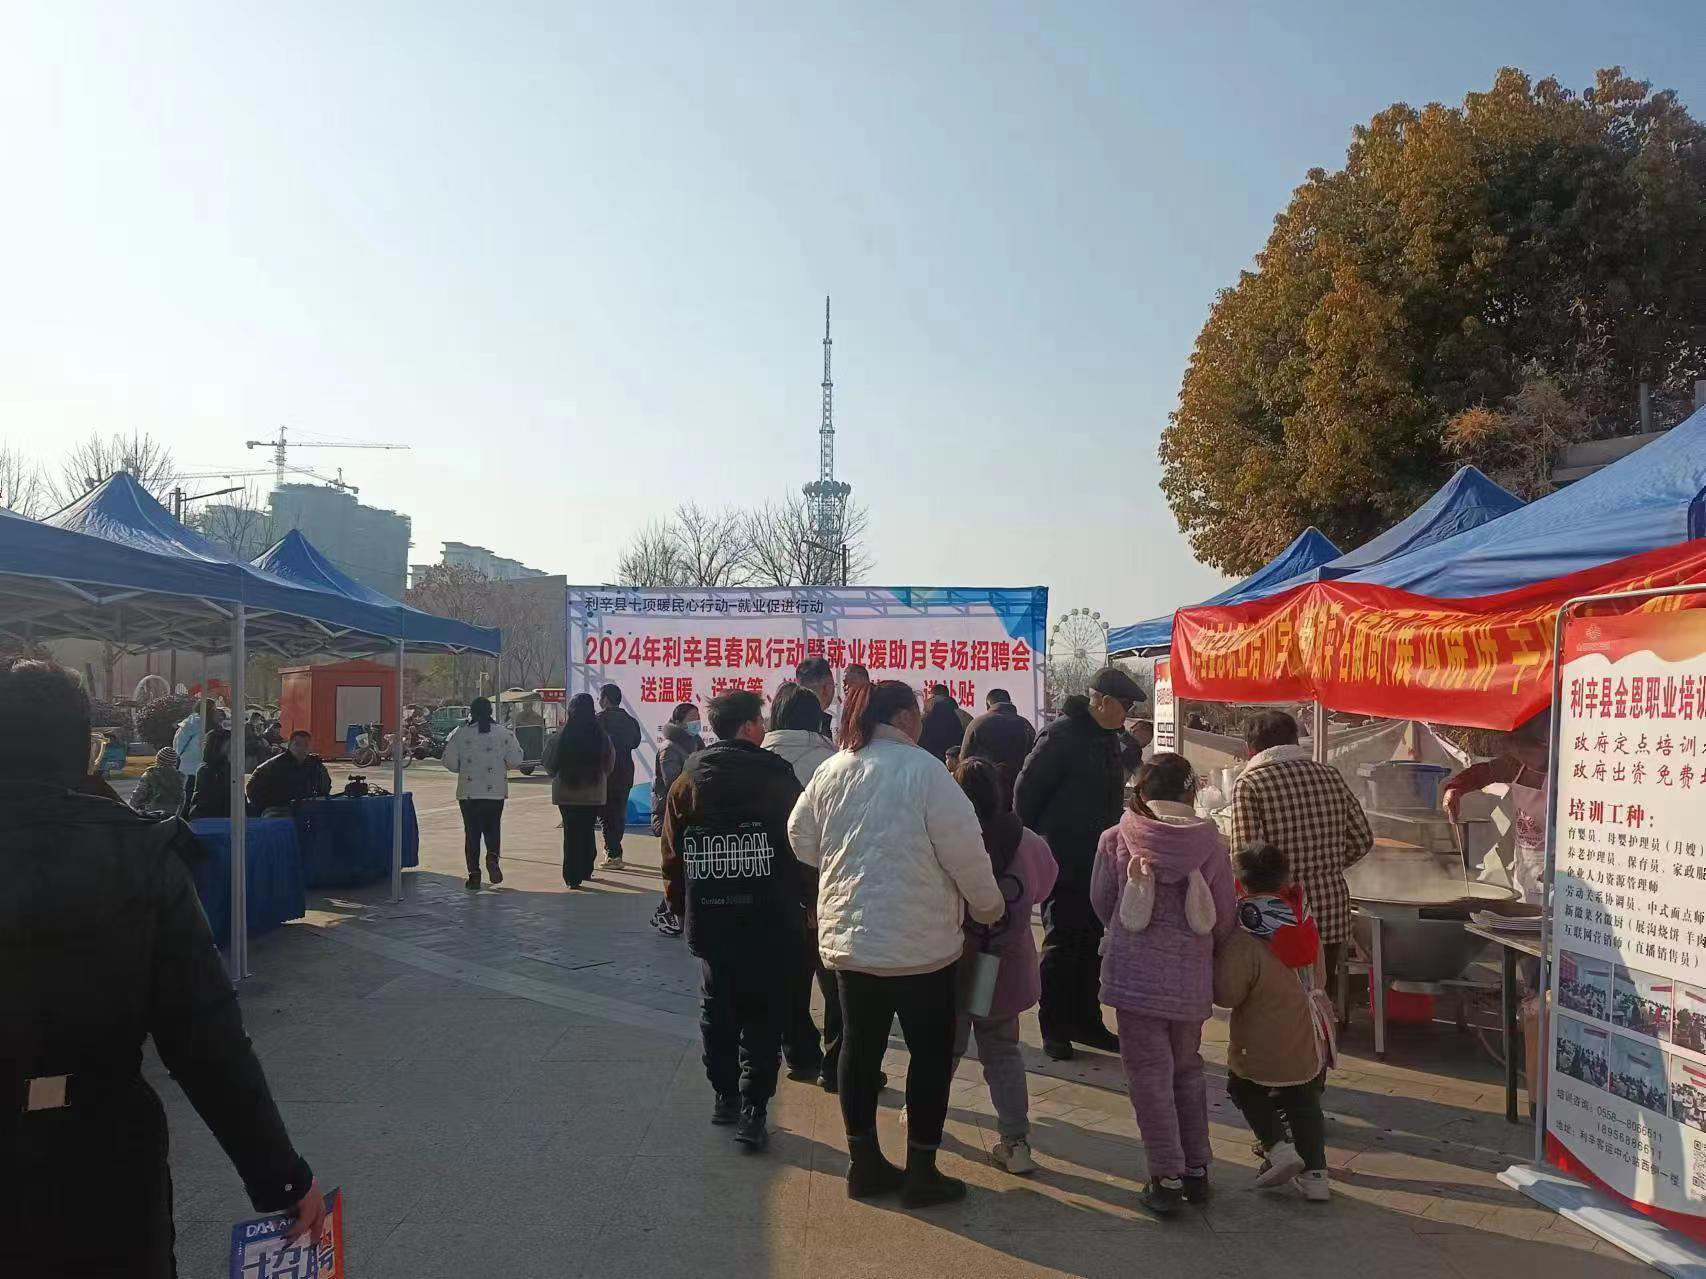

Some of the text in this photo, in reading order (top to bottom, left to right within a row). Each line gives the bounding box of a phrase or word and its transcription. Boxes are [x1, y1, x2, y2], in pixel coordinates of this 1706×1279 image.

[585, 636, 1030, 672] 2024年利辛县春风行动暨就业援助月专场招聘会
[1574, 731, 1706, 757] 政府定点培训
[1567, 866, 1659, 894] 企业人力资源管理师
